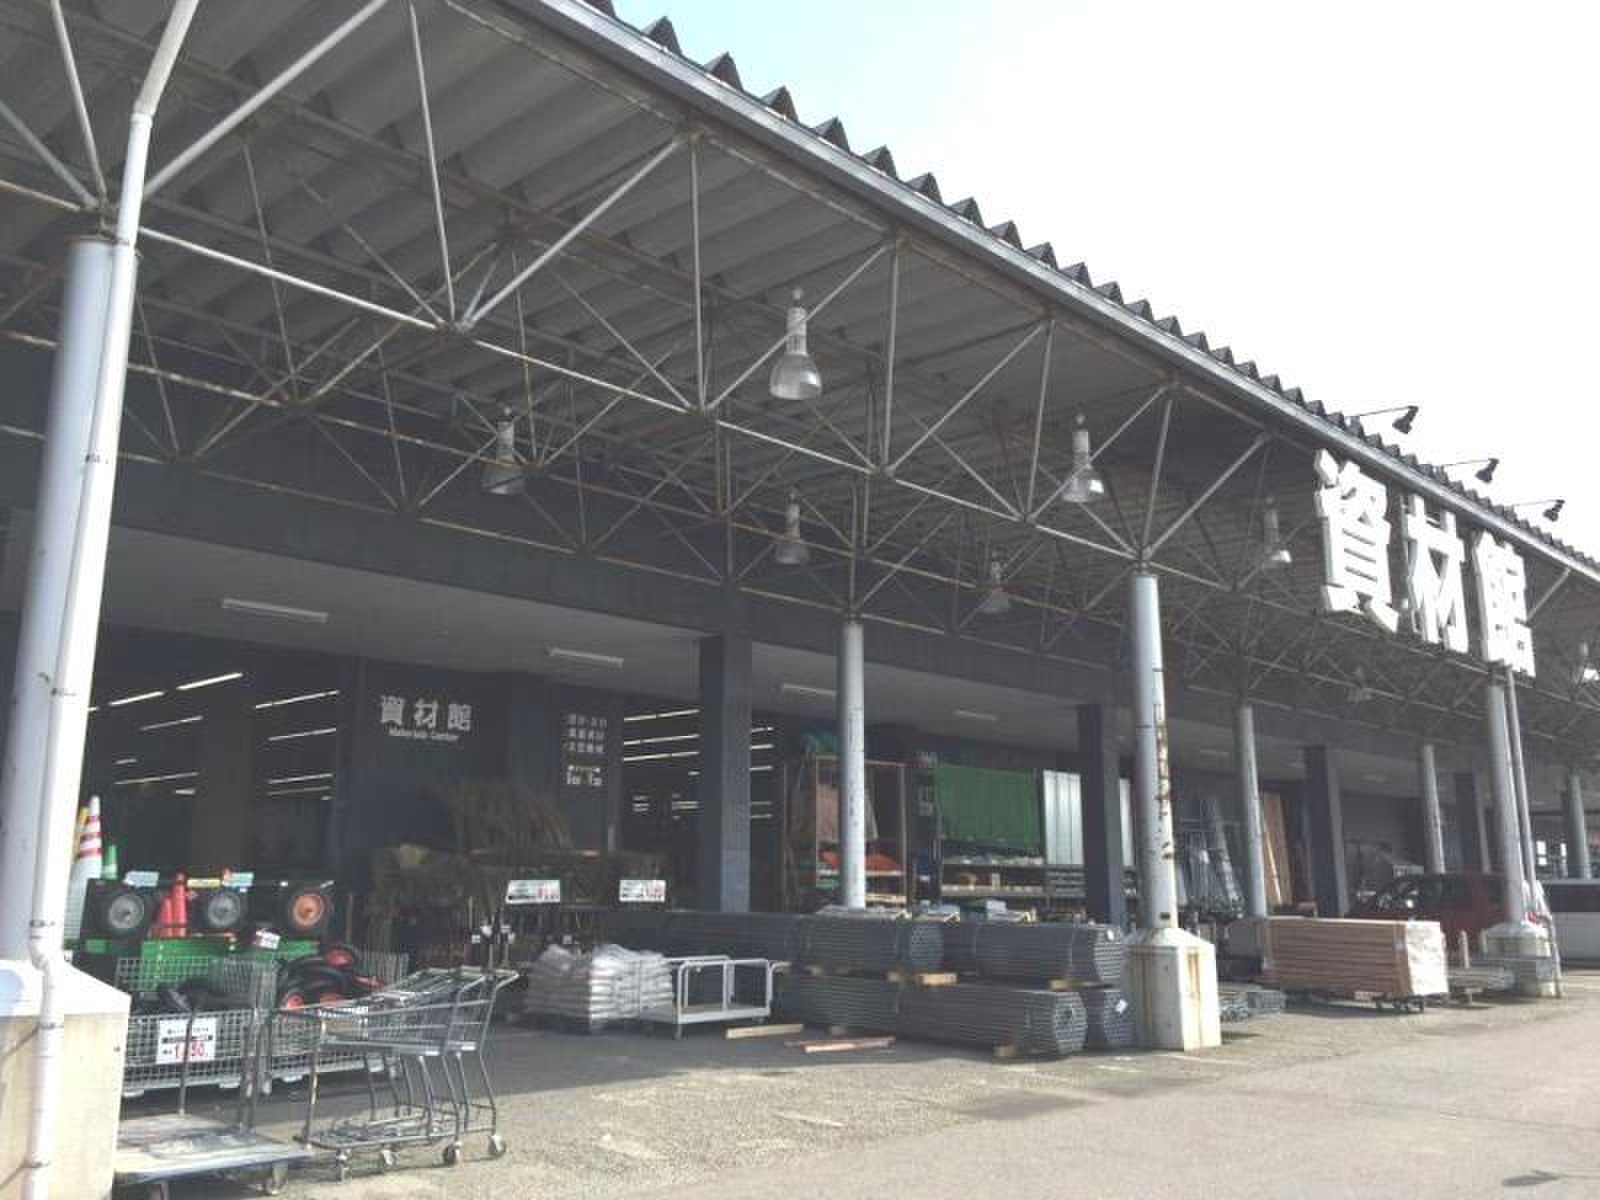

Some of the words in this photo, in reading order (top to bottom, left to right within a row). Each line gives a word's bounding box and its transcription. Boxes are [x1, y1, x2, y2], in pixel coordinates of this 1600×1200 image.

[1314, 449, 1535, 677] 資材館
[380, 695, 471, 731] 資材館
